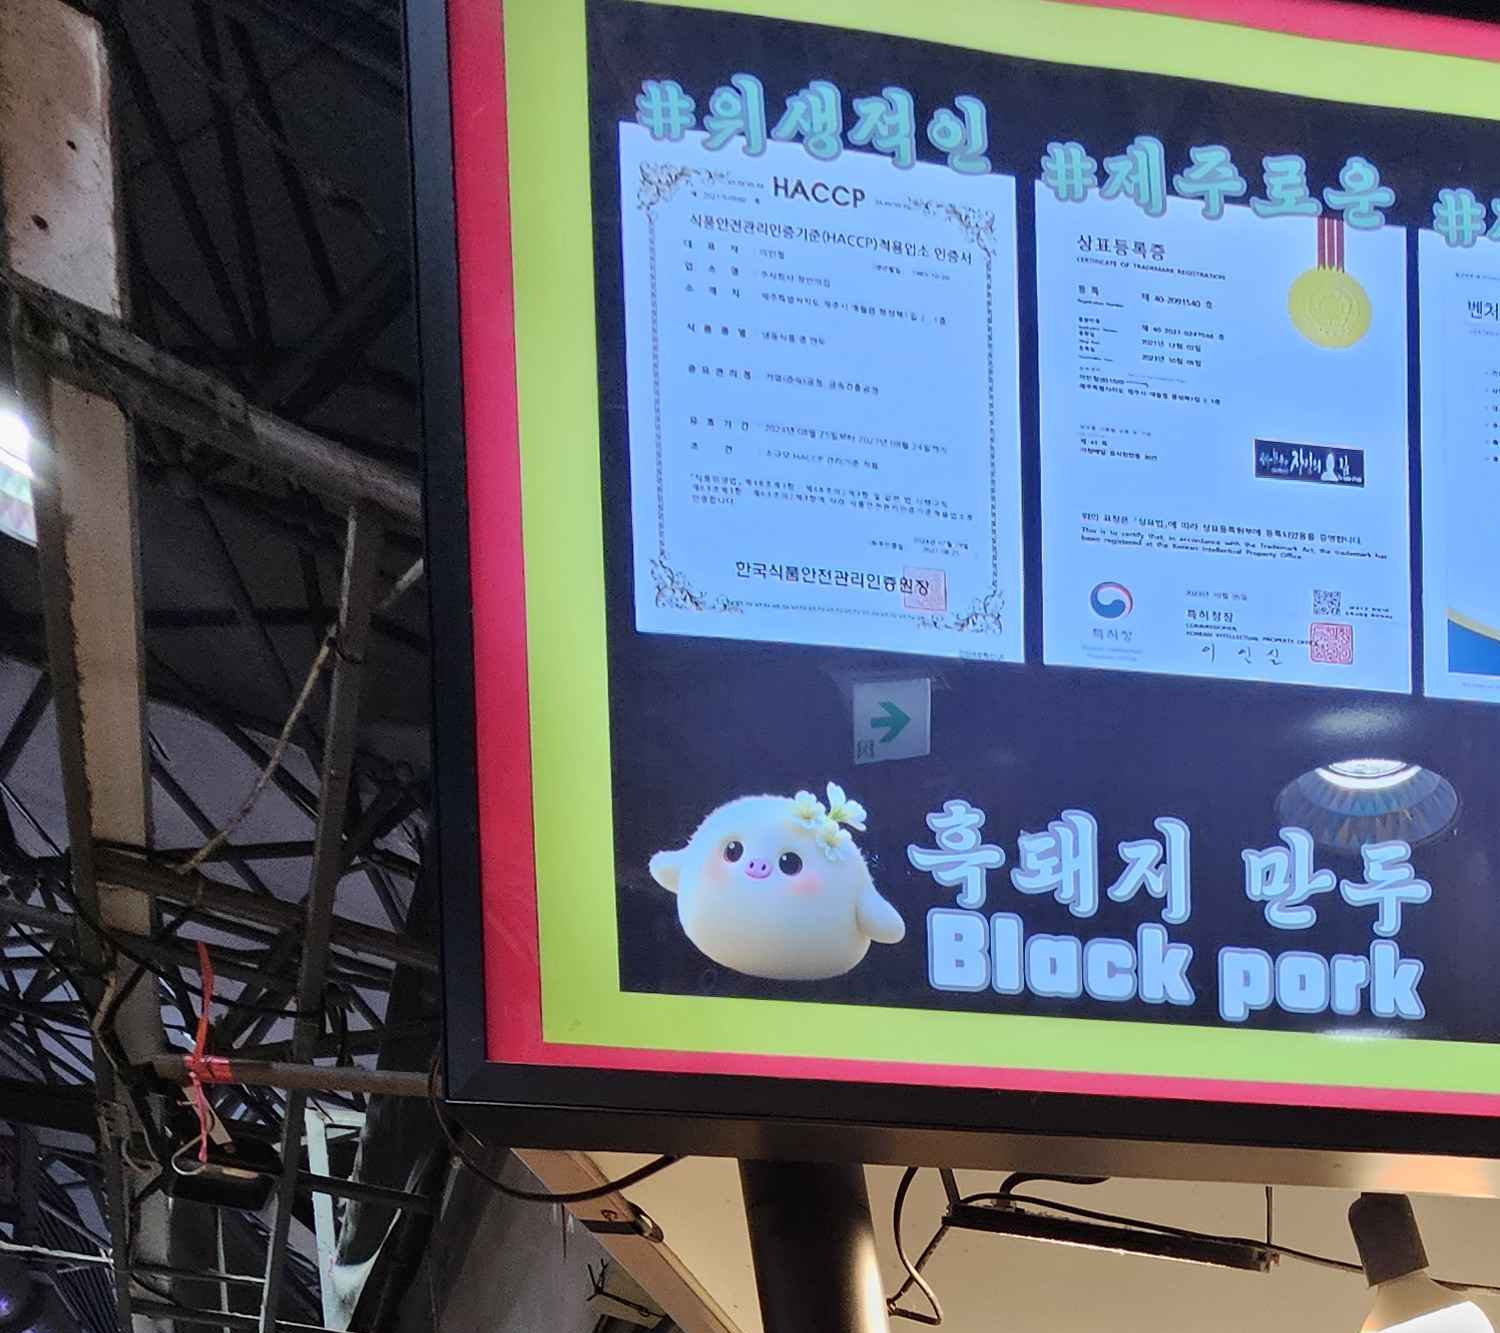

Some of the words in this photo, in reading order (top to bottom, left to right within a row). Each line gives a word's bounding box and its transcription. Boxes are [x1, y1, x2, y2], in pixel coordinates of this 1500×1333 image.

[635, 73, 991, 174] #위생적인
[773, 176, 866, 208] HACCP
[1041, 136, 1395, 230] #제주로운
[1077, 235, 1166, 261] 상표등록증
[907, 799, 1192, 926] 흑돼지
[1244, 827, 1432, 935] 만두
[926, 906, 1196, 1006] Black
[1217, 938, 1427, 1023] pork
